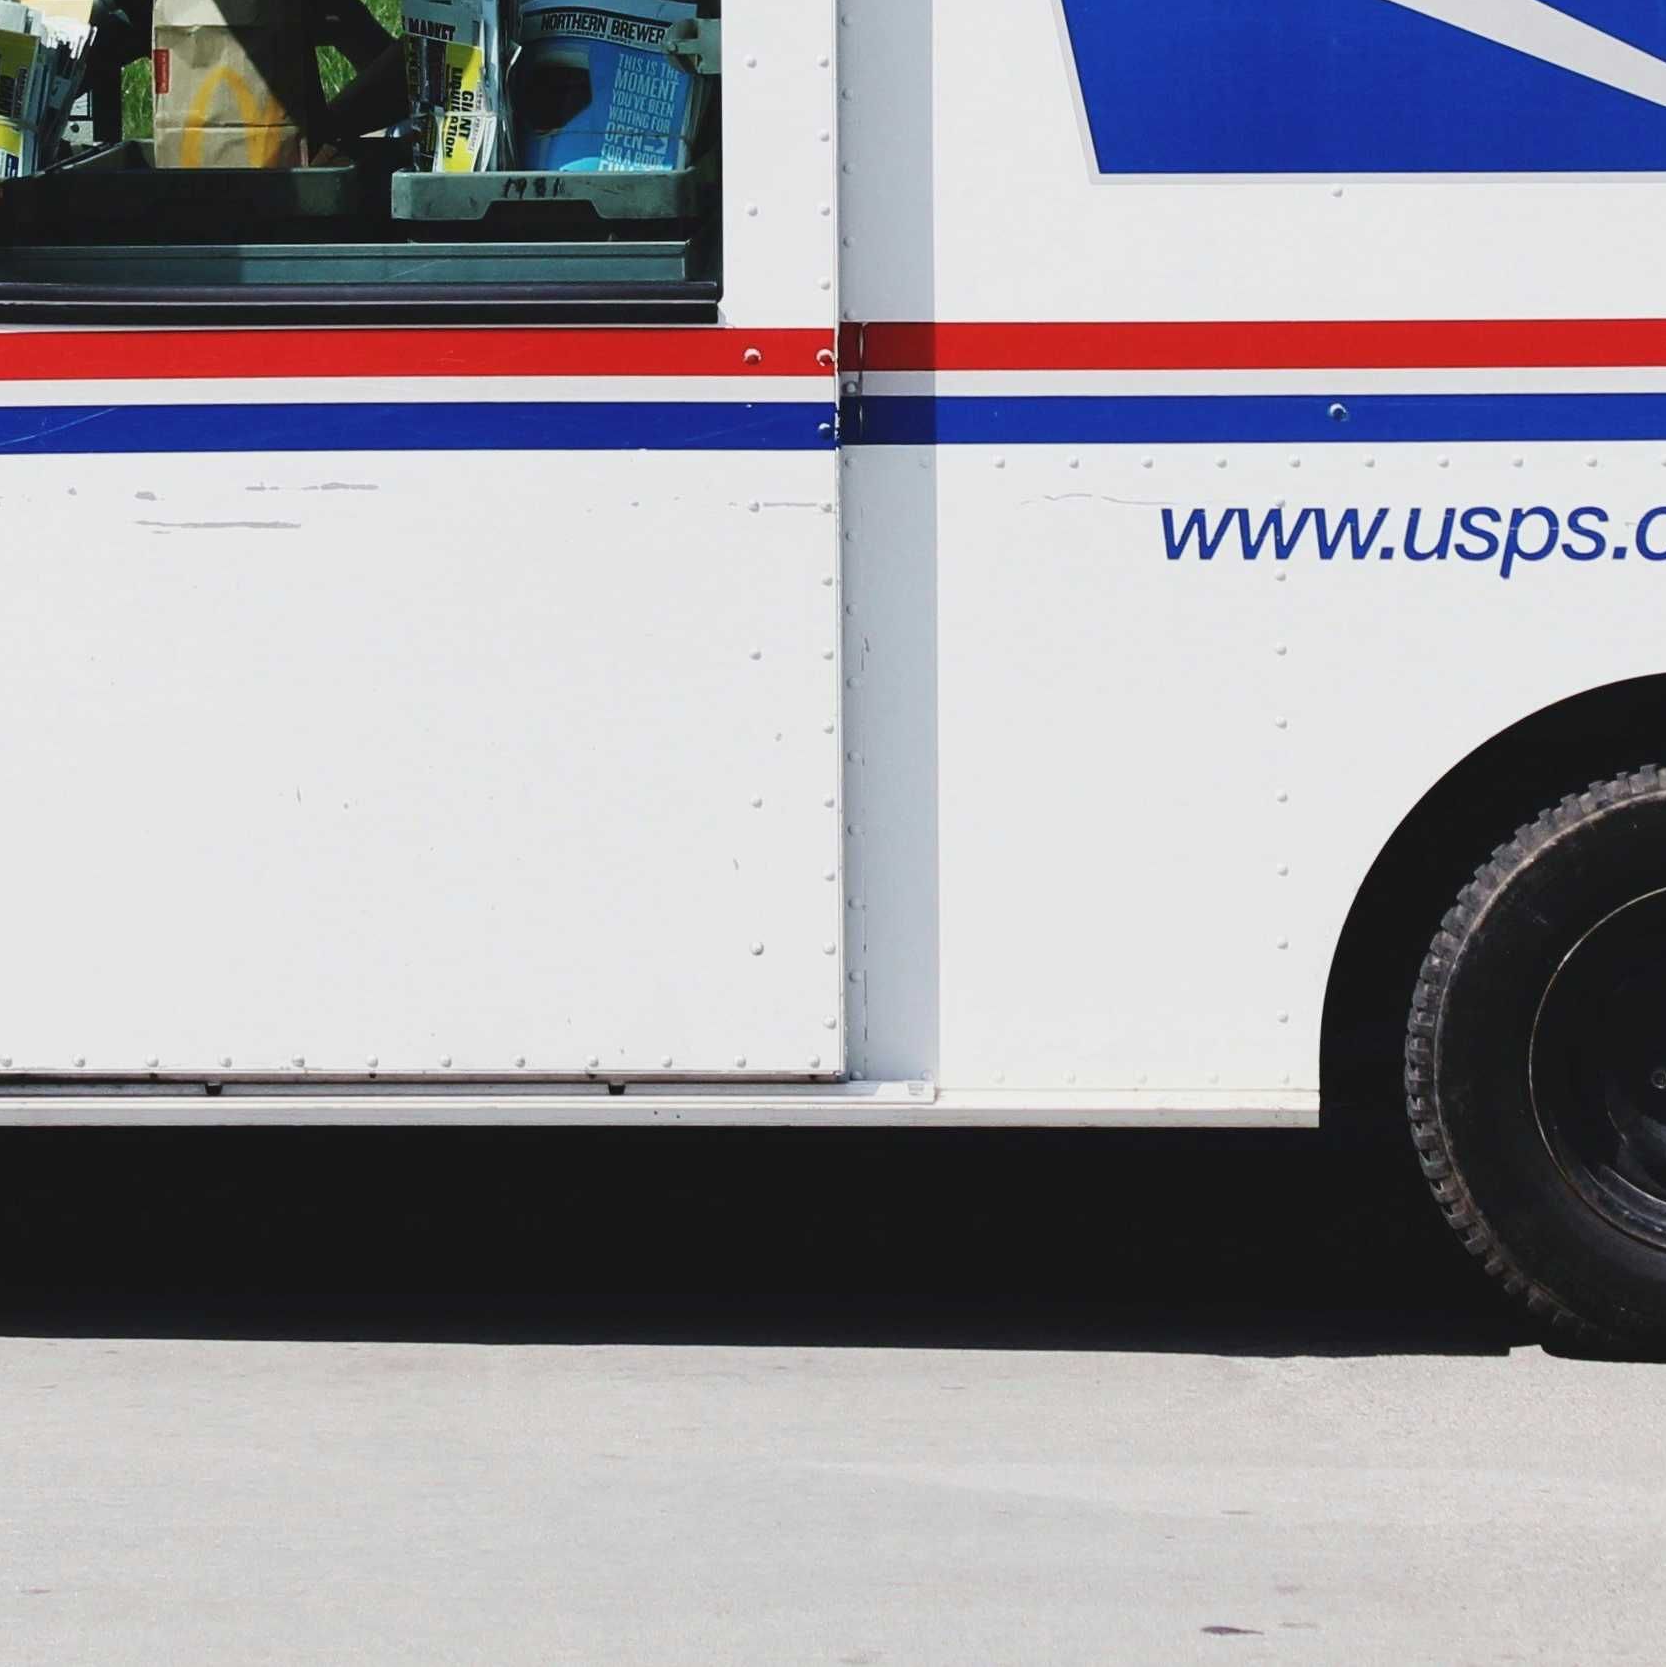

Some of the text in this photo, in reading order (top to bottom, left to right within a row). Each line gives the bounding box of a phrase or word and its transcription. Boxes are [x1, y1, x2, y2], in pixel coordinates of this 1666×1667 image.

[541, 13, 666, 45] NORTHERN BREWER
[617, 54, 644, 72] THIS
[645, 60, 658, 75] IS
[614, 68, 680, 101] MOMENT
[609, 104, 670, 134] WAITING FOR
[648, 98, 674, 117] BEEN
[604, 121, 643, 149] OPEN
[601, 142, 622, 163] FOR
